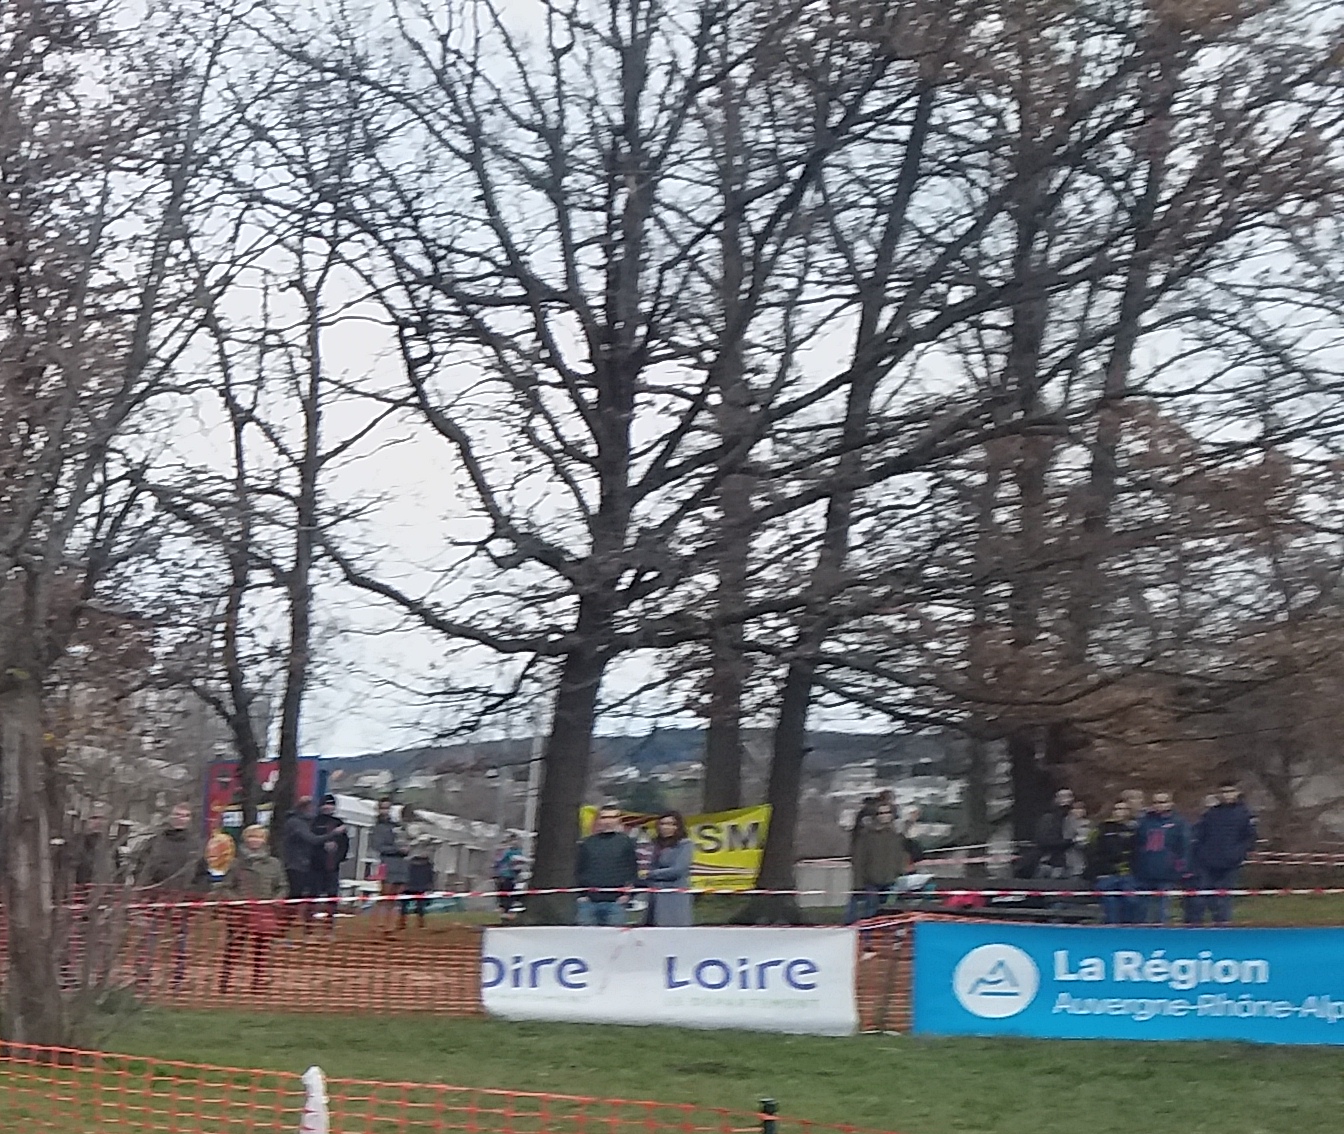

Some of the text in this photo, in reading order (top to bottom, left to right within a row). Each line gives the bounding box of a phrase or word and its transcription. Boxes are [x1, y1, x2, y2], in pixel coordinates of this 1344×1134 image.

[696, 821, 760, 853] SM
[664, 955, 819, 991] Loire
[1052, 948, 1270, 990] La Région
